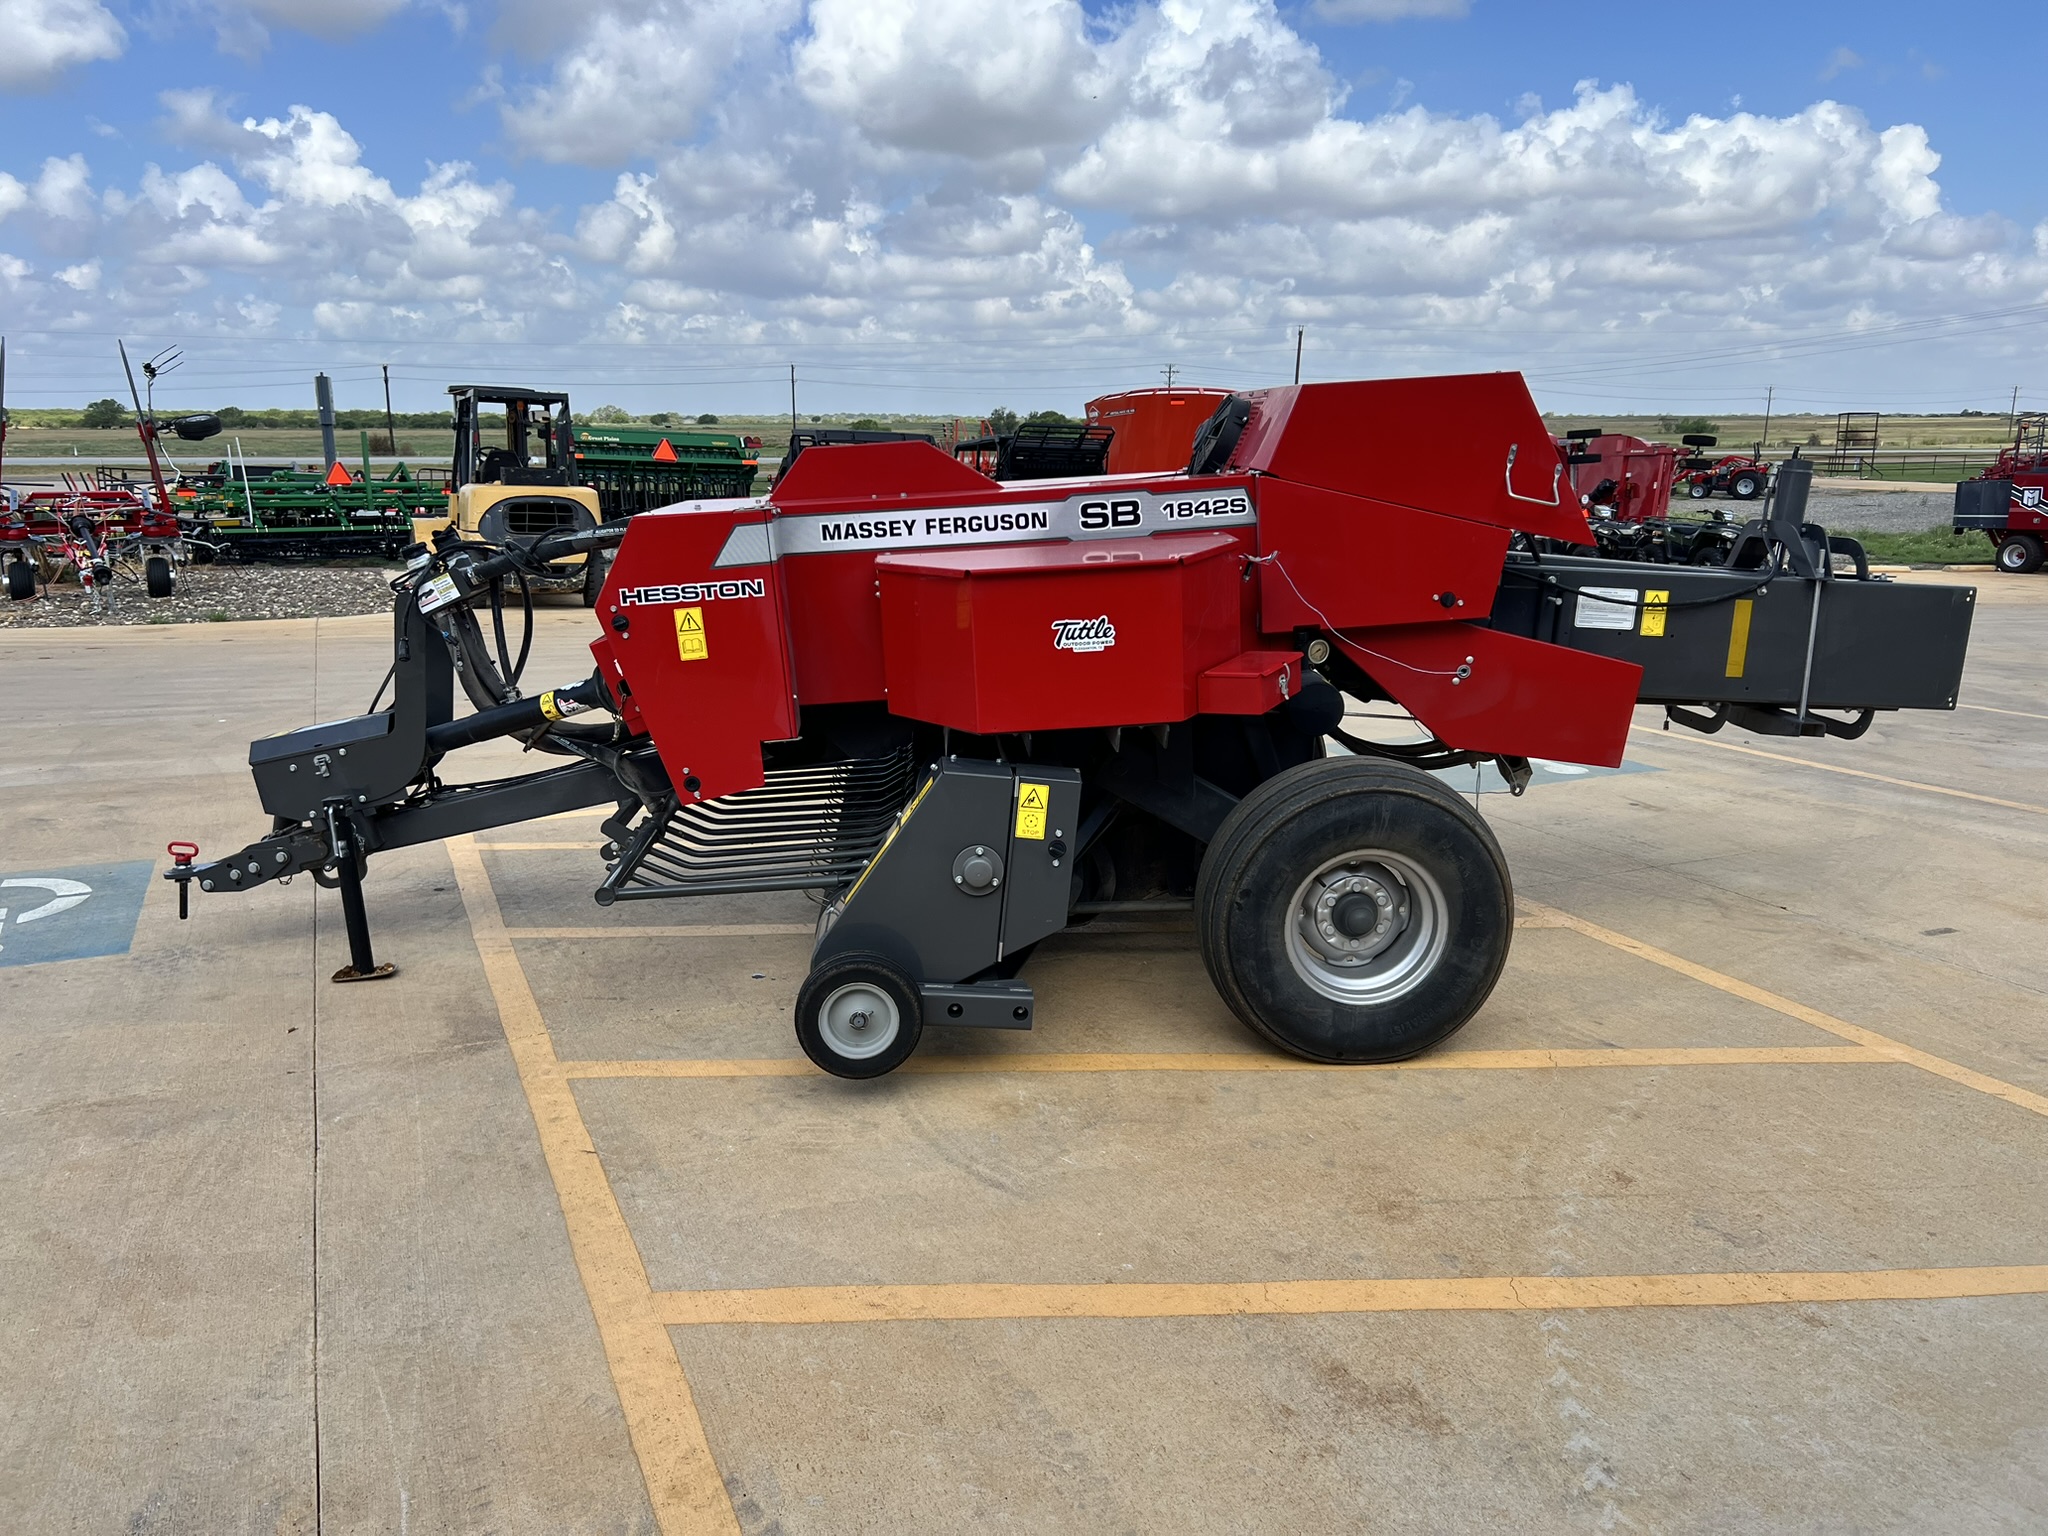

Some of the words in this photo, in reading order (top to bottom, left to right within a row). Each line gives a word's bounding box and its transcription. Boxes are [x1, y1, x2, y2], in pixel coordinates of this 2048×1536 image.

[821, 518, 917, 541] MASSEY
[925, 511, 1048, 535] FERGUSON
[1080, 500, 1141, 529] SB
[1162, 498, 1247, 519] 1842S
[620, 580, 763, 605] HESSTON
[1053, 617, 1114, 648] Tuttle
